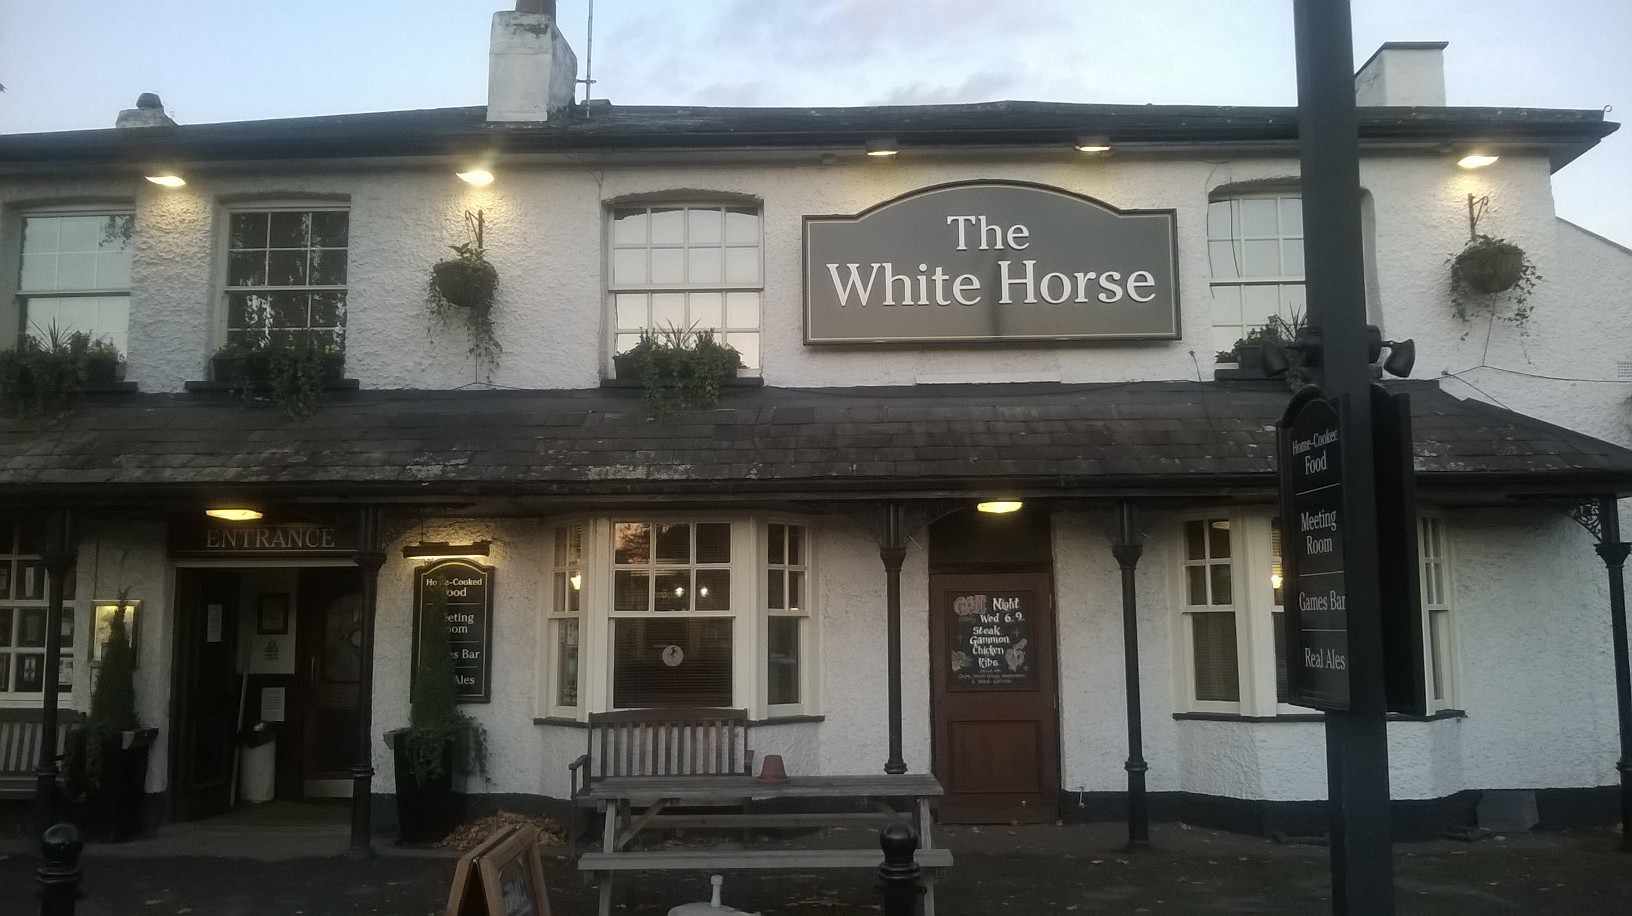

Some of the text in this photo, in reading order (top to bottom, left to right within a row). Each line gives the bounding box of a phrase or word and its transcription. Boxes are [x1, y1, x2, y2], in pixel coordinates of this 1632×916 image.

[946, 215, 1030, 250] The
[826, 260, 1156, 306] White Horse
[1304, 450, 1327, 475] Food
[1300, 509, 1337, 532] Meeting
[207, 527, 336, 548] ENTRANCE
[1306, 535, 1333, 555] Room
[426, 578, 482, 586] Hoe-Cooked
[446, 586, 467, 597] ood
[992, 597, 1020, 611] Night
[1299, 590, 1346, 611] Games Bar
[448, 613, 475, 624] eting
[980, 613, 1000, 623] Wed
[973, 625, 1000, 635] Steak
[969, 635, 1010, 645] Gammon
[462, 649, 480, 658] Bar
[972, 643, 1004, 656] Chicken
[1304, 647, 1345, 670] Real Ales
